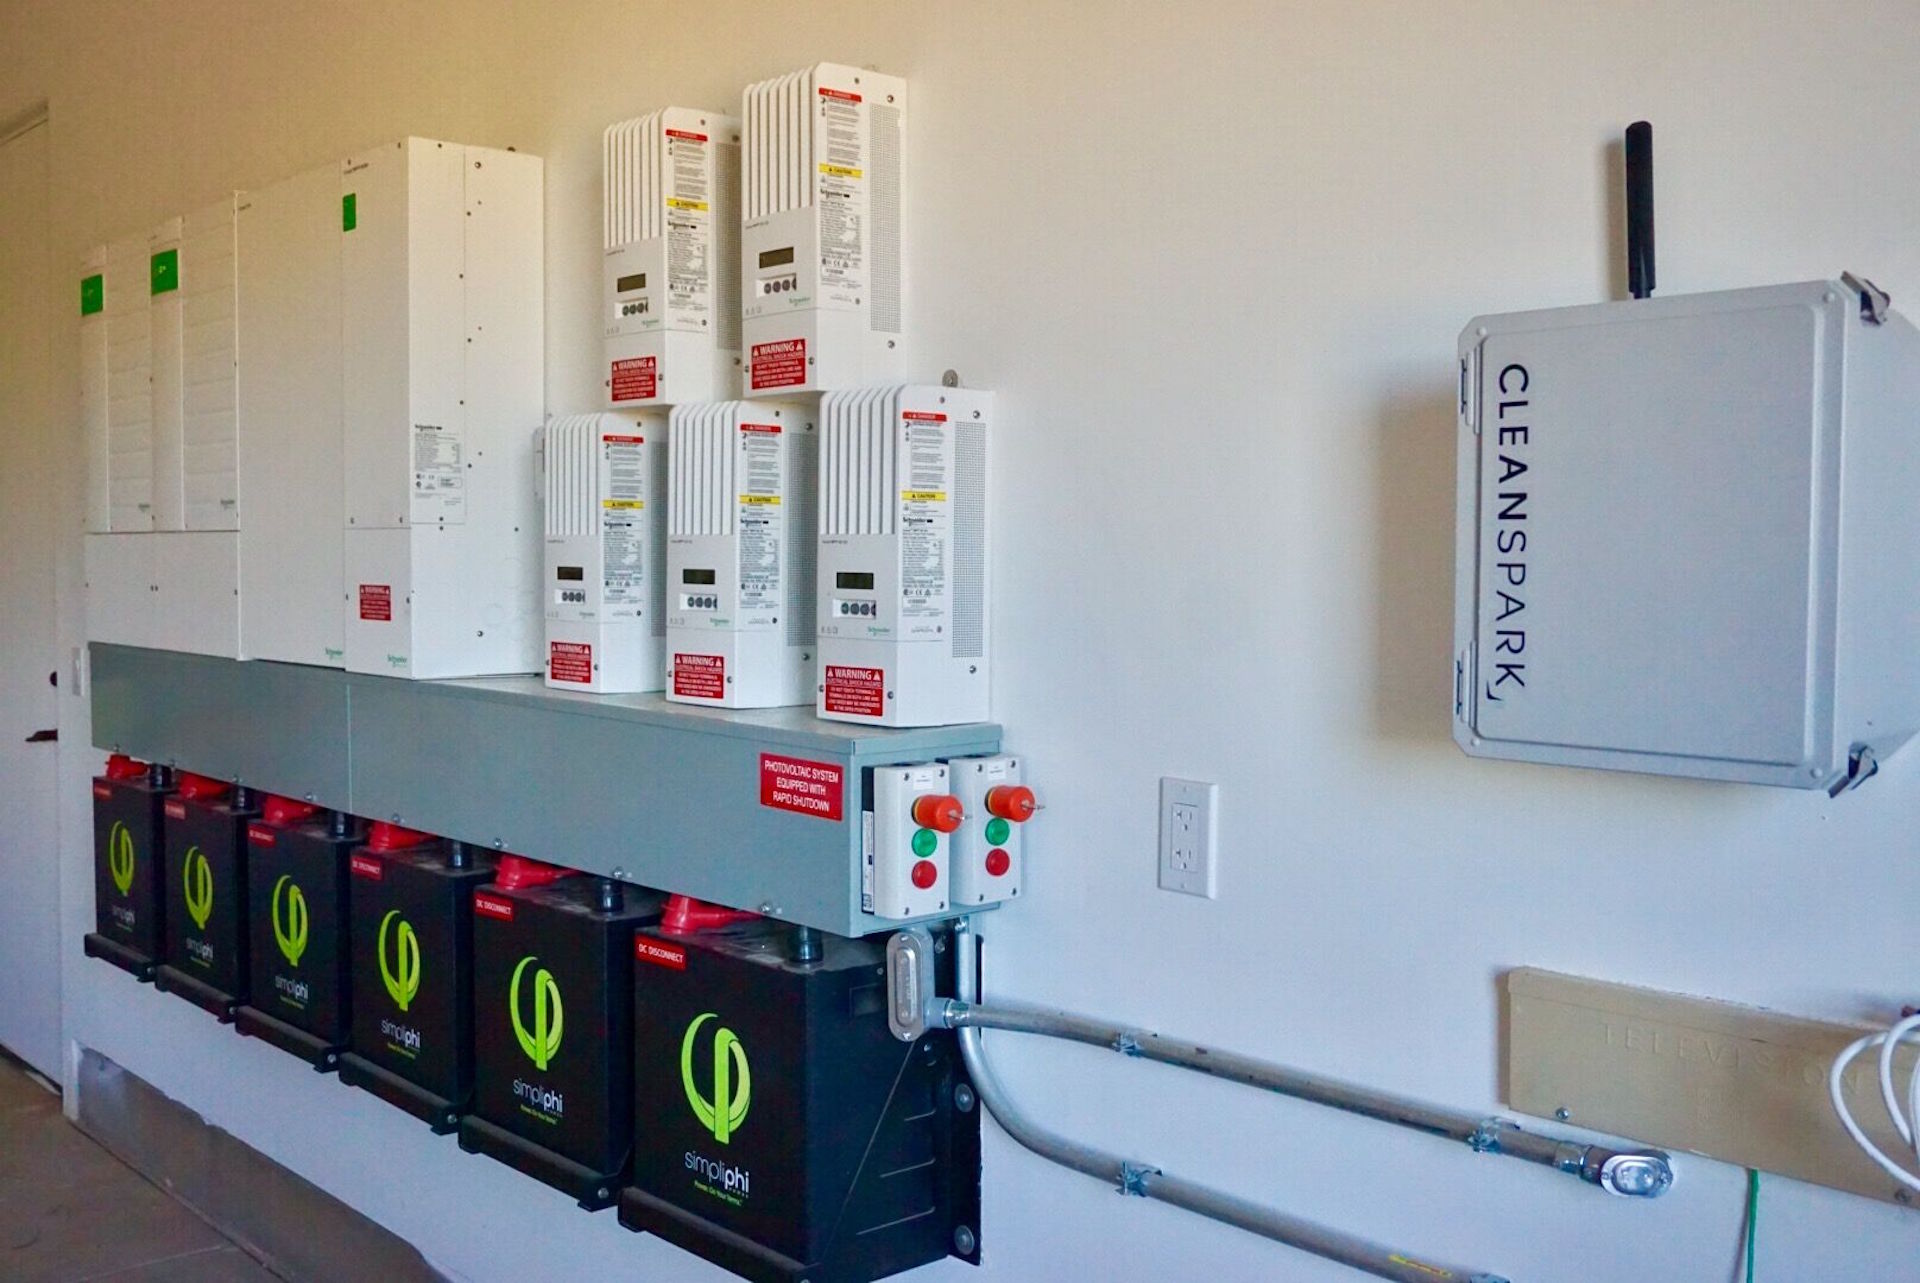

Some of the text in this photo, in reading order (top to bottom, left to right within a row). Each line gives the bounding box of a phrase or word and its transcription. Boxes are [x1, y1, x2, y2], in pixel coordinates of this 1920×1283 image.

[760, 341, 795, 356] WARNING
[1495, 363, 1529, 687] CLEANSPARK
[681, 655, 714, 667] WARNING
[834, 667, 872, 681] WARNING
[764, 760, 839, 783] PHOTOVOLTAIC SYSTEM
[776, 776, 826, 795] EQUIPPED WITH
[772, 791, 830, 812] RAPID SHUTDOWN
[638, 943, 684, 963] DC DISCONNECT
[513, 1078, 562, 1112] simpliphi
[685, 1150, 749, 1193] simpliphi
